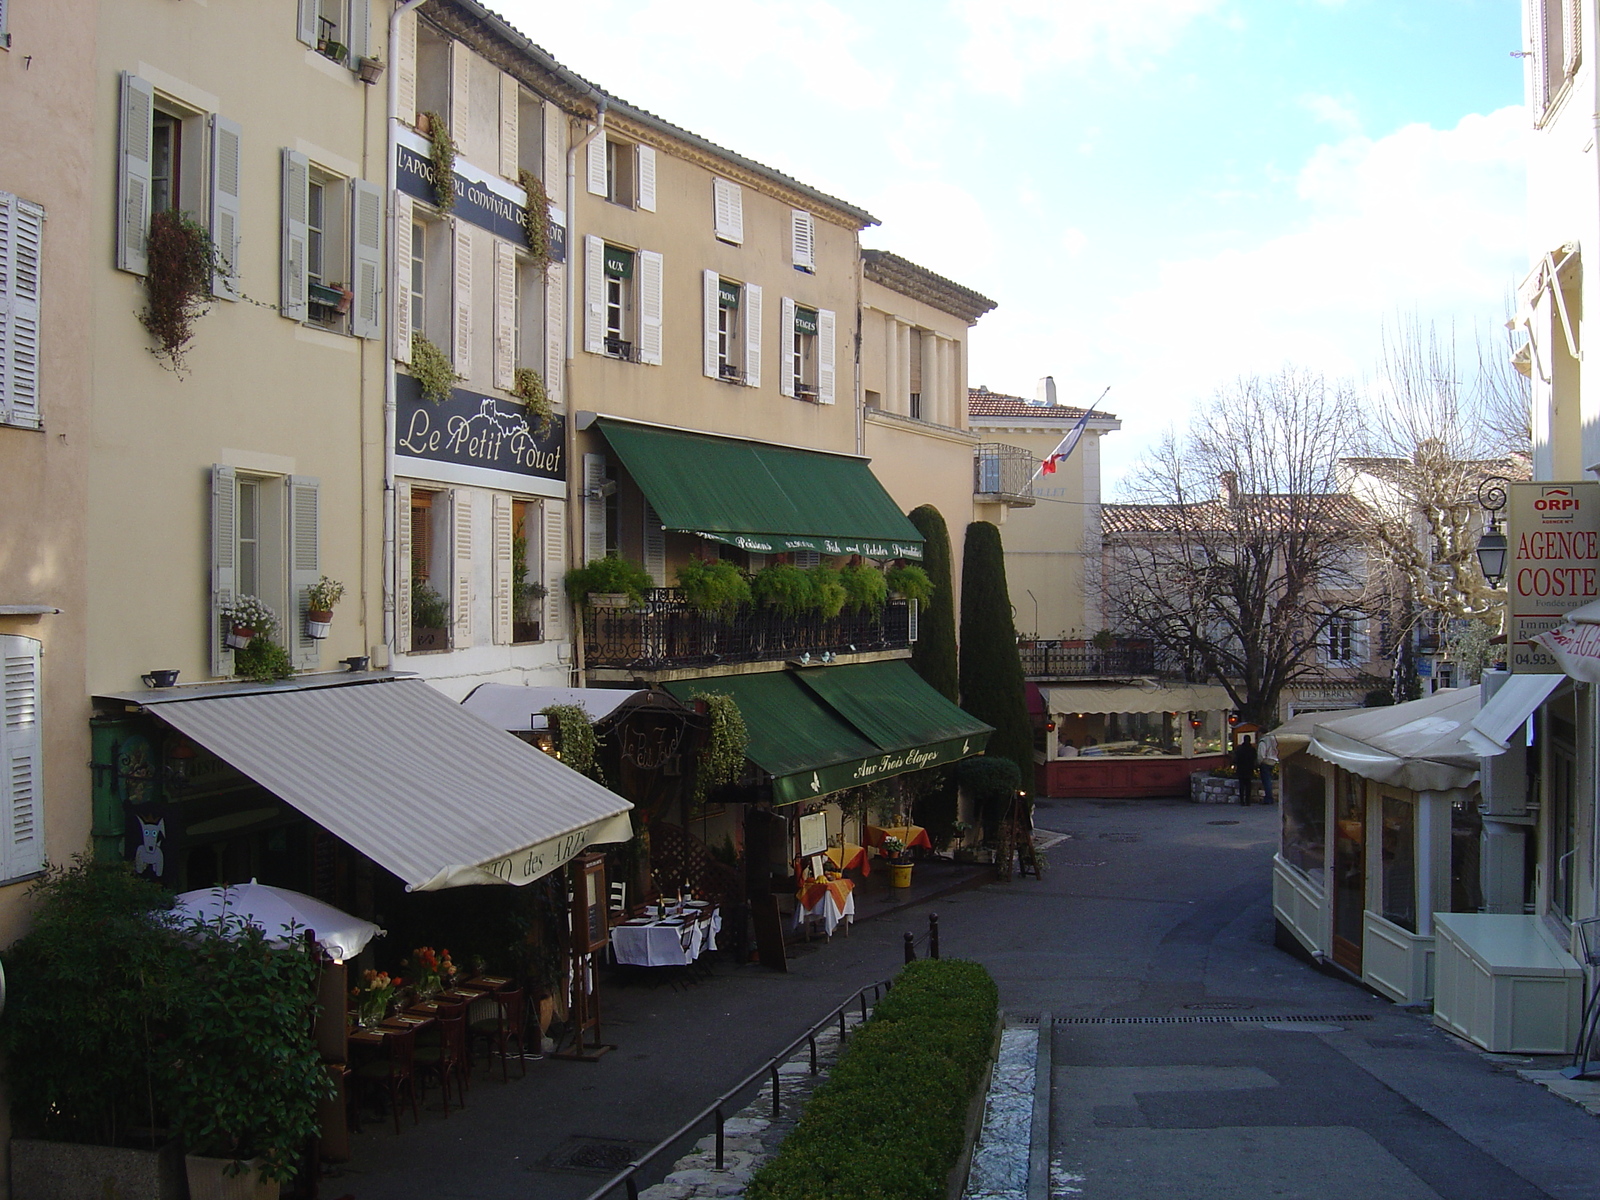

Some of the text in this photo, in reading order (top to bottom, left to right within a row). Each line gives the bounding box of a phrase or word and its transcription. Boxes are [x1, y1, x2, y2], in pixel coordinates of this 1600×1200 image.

[398, 146, 437, 185] L'APOG
[468, 187, 513, 222] CONVIVIAL
[608, 259, 624, 272] AUX
[399, 408, 441, 454] Le
[447, 415, 502, 461] Petit
[1534, 499, 1580, 511] ORPI
[1517, 532, 1598, 559] AGENCE
[1517, 567, 1598, 597] COSTE
[853, 748, 939, 779] Aux Trois Etages
[523, 851, 545, 877] des
[551, 829, 590, 866] ARTS
